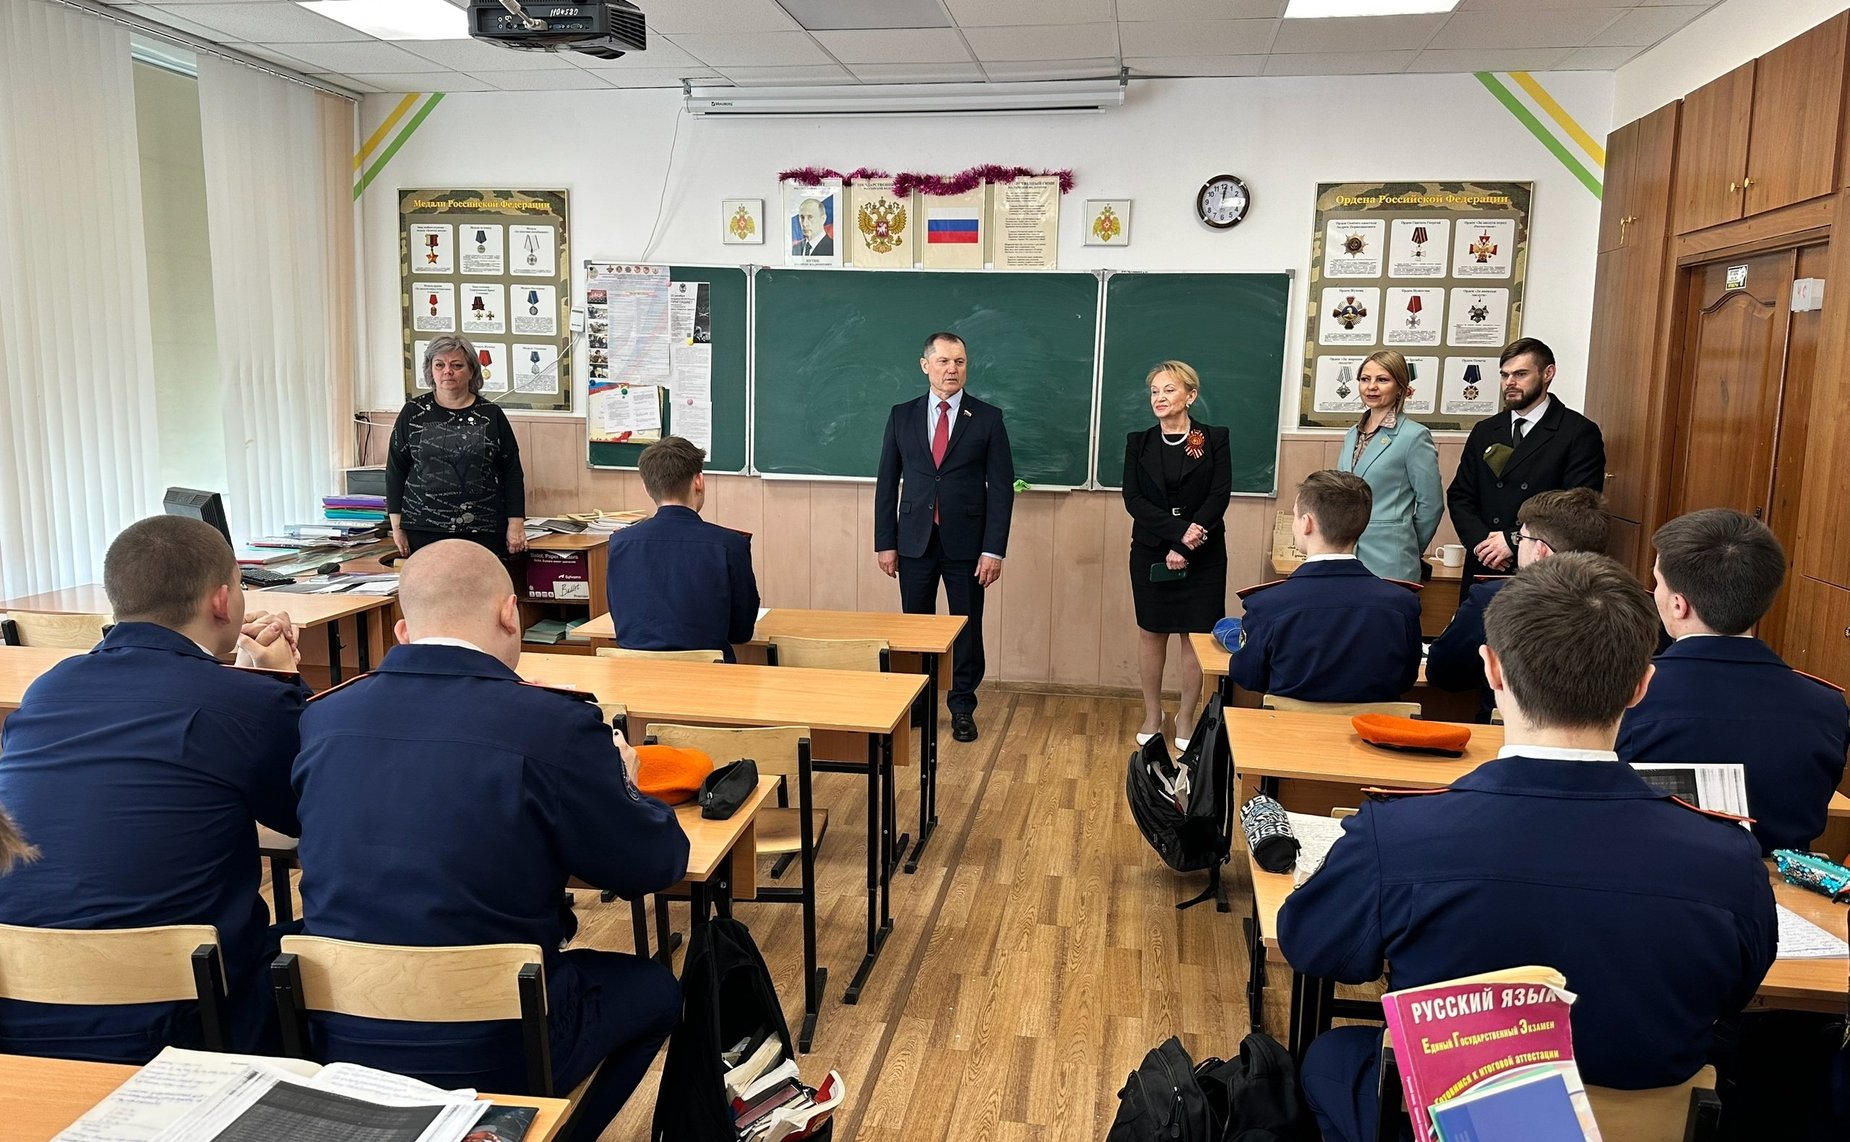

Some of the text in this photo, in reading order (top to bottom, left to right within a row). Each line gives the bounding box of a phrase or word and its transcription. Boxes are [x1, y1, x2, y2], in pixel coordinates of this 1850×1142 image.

[413, 199, 551, 210] Медали Российской Федерации
[1336, 194, 1508, 206] Ордена Российской Федерации
[1411, 987, 1494, 1024] РУССКИЙ
[1472, 1071, 1479, 1080] к
[1479, 1055, 1514, 1077] итоговой
[1515, 1049, 1559, 1064] аттестации
